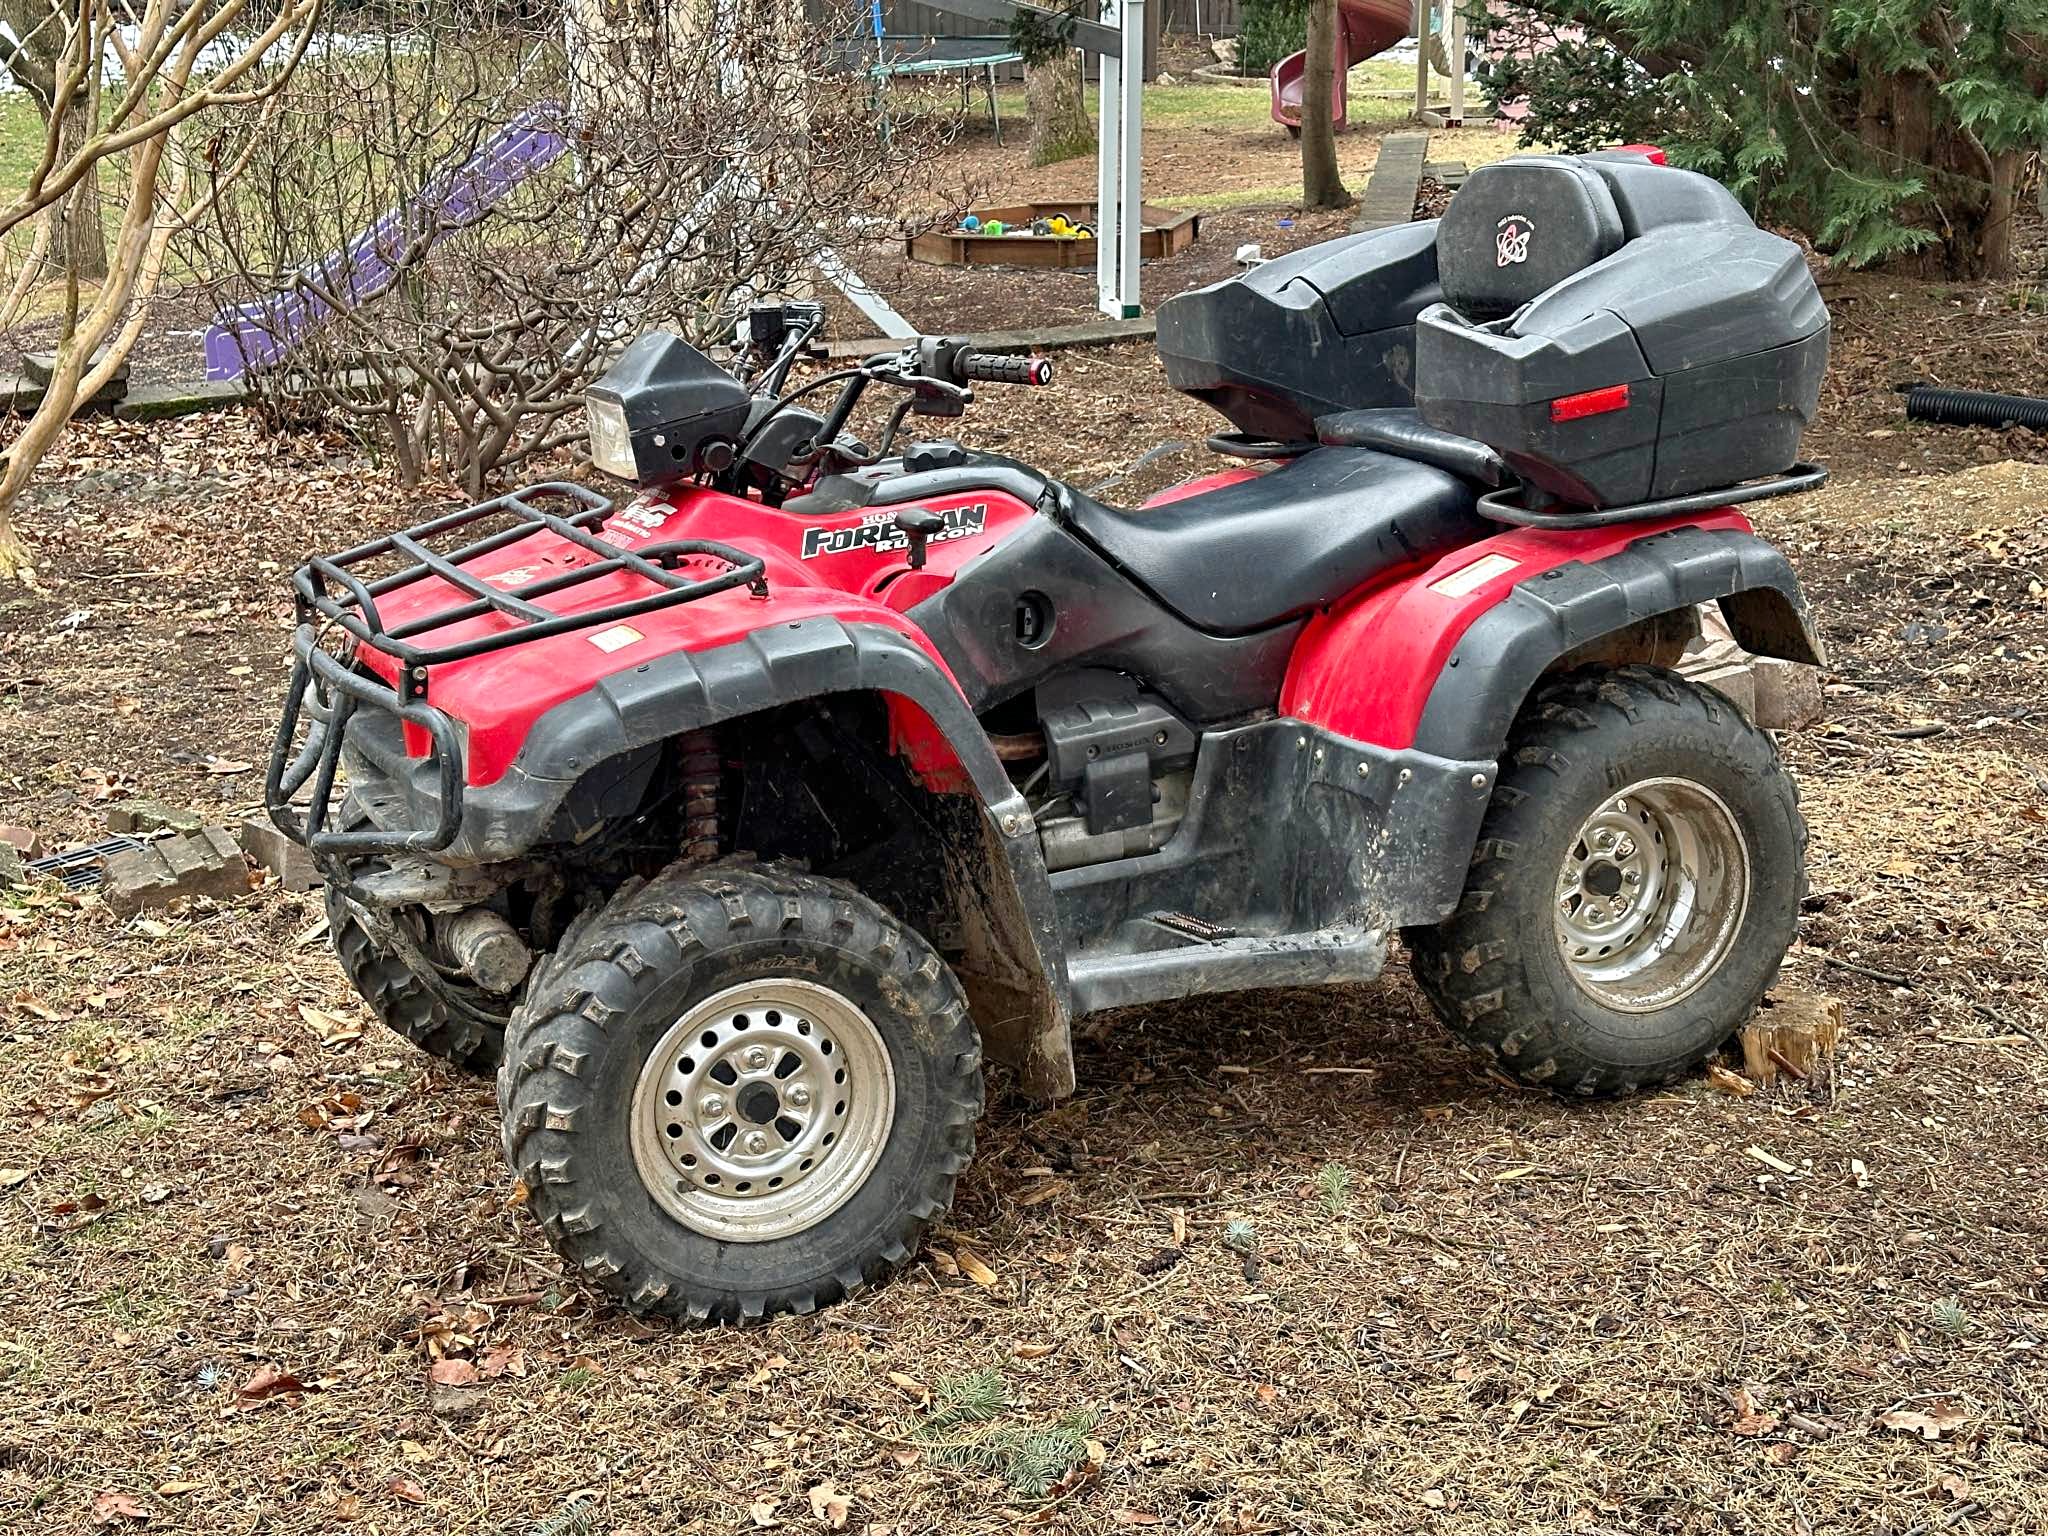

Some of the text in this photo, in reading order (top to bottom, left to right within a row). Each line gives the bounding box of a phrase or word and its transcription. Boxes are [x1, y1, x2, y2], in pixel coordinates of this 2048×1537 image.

[801, 504, 987, 559] FOREAN
[862, 511, 898, 526] HON
[875, 524, 984, 553] RUICON
